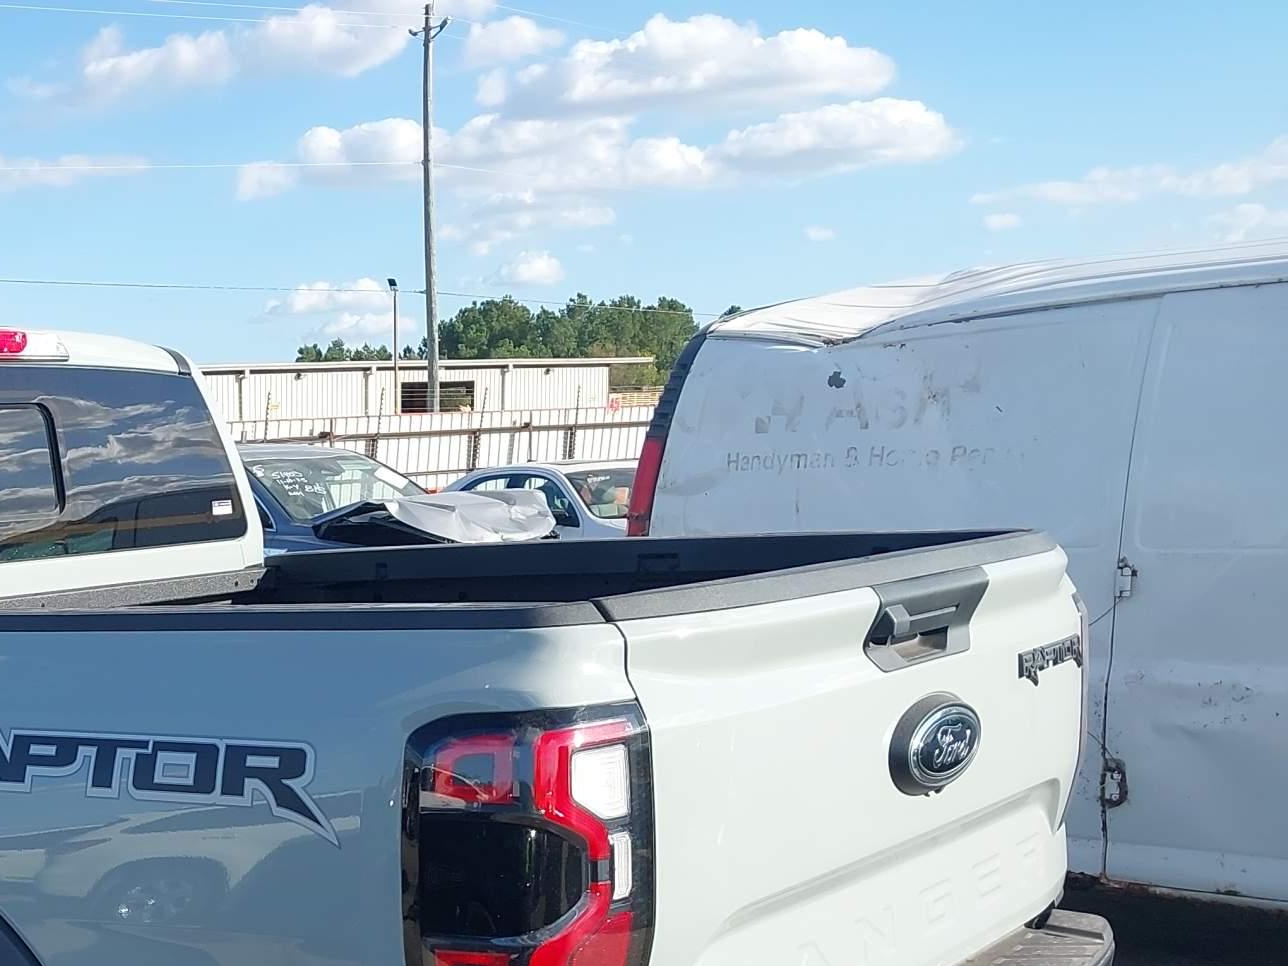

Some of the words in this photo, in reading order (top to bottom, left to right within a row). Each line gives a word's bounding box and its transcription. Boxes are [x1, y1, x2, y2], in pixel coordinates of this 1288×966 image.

[726, 450, 835, 475] Handyman
[868, 446, 940, 468] Hoe
[1017, 633, 1083, 687] RAPTOR
[932, 722, 972, 768] Ford
